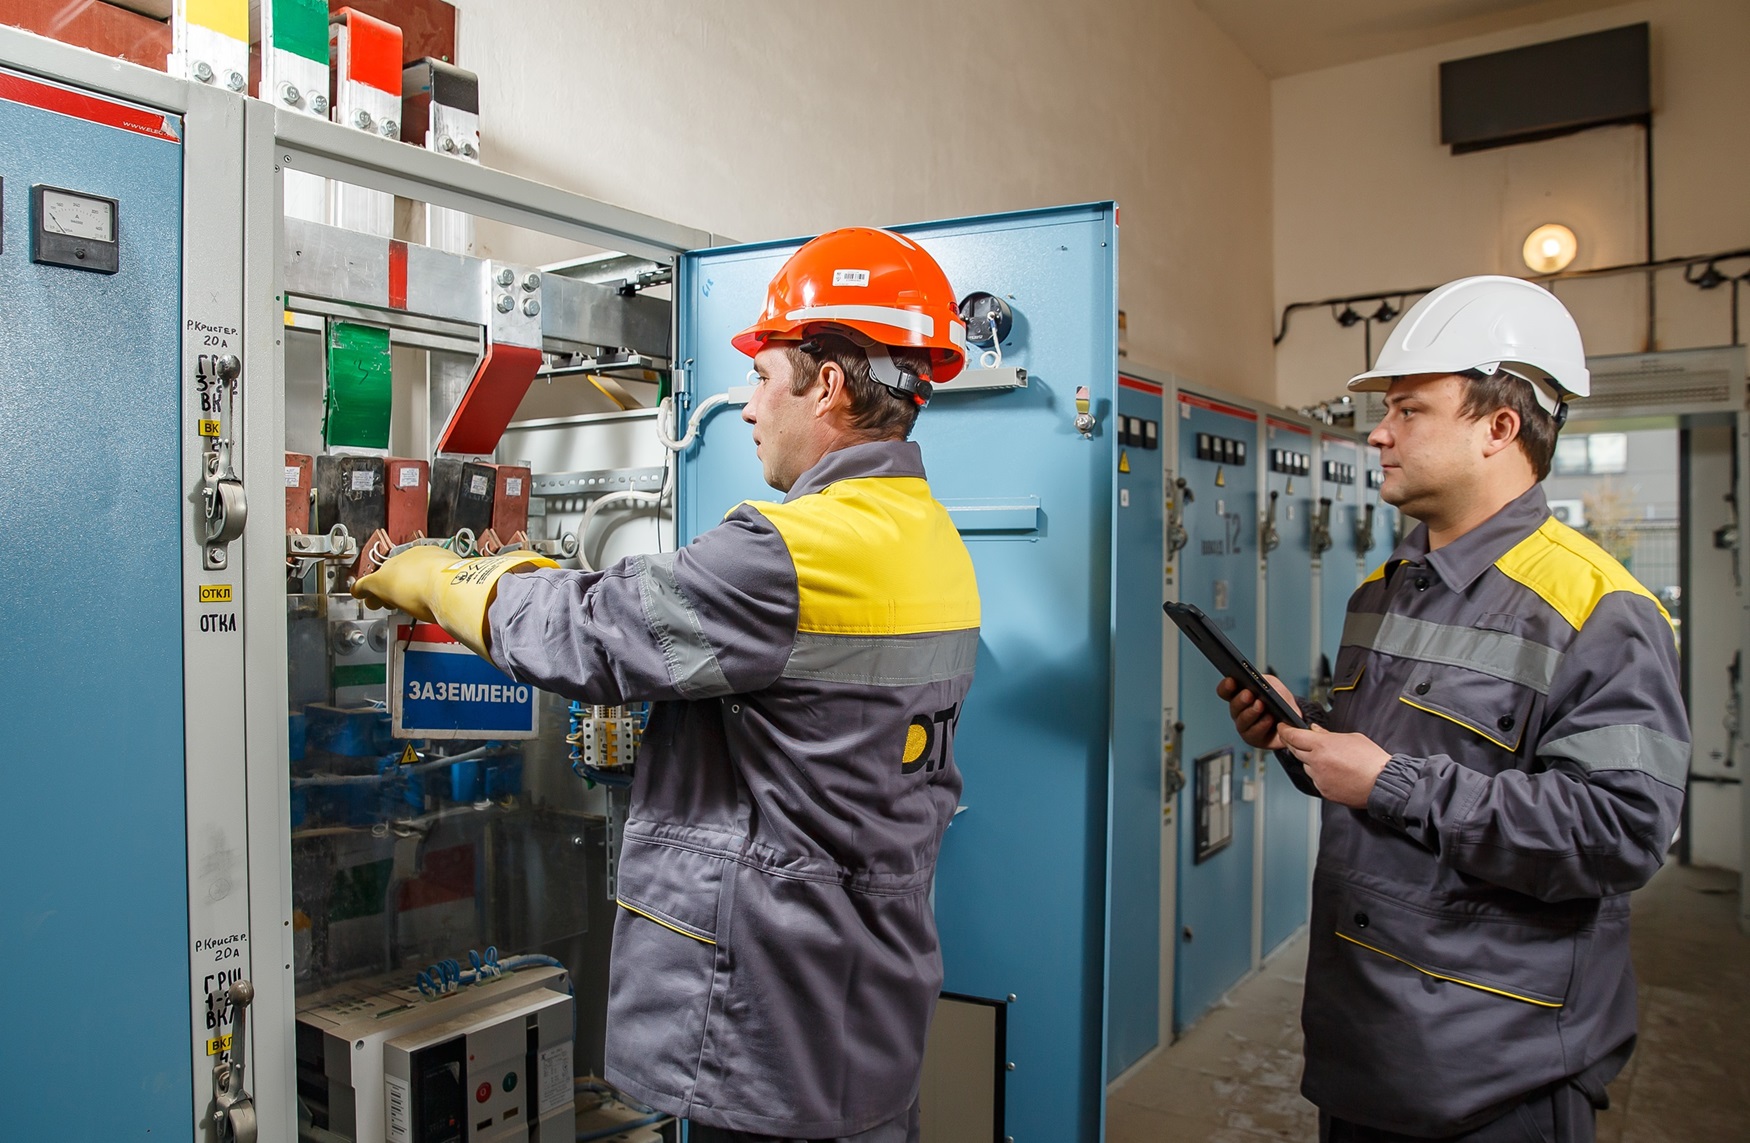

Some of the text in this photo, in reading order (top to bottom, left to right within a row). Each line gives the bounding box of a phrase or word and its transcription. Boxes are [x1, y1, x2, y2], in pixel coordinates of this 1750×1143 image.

[204, 423, 219, 433] ВК
[202, 588, 231, 599] ОТКЛ
[200, 612, 237, 633] ОТКЛ
[408, 680, 529, 704] ЗАЗЕМЛЕНО
[901, 699, 964, 775] D.T
